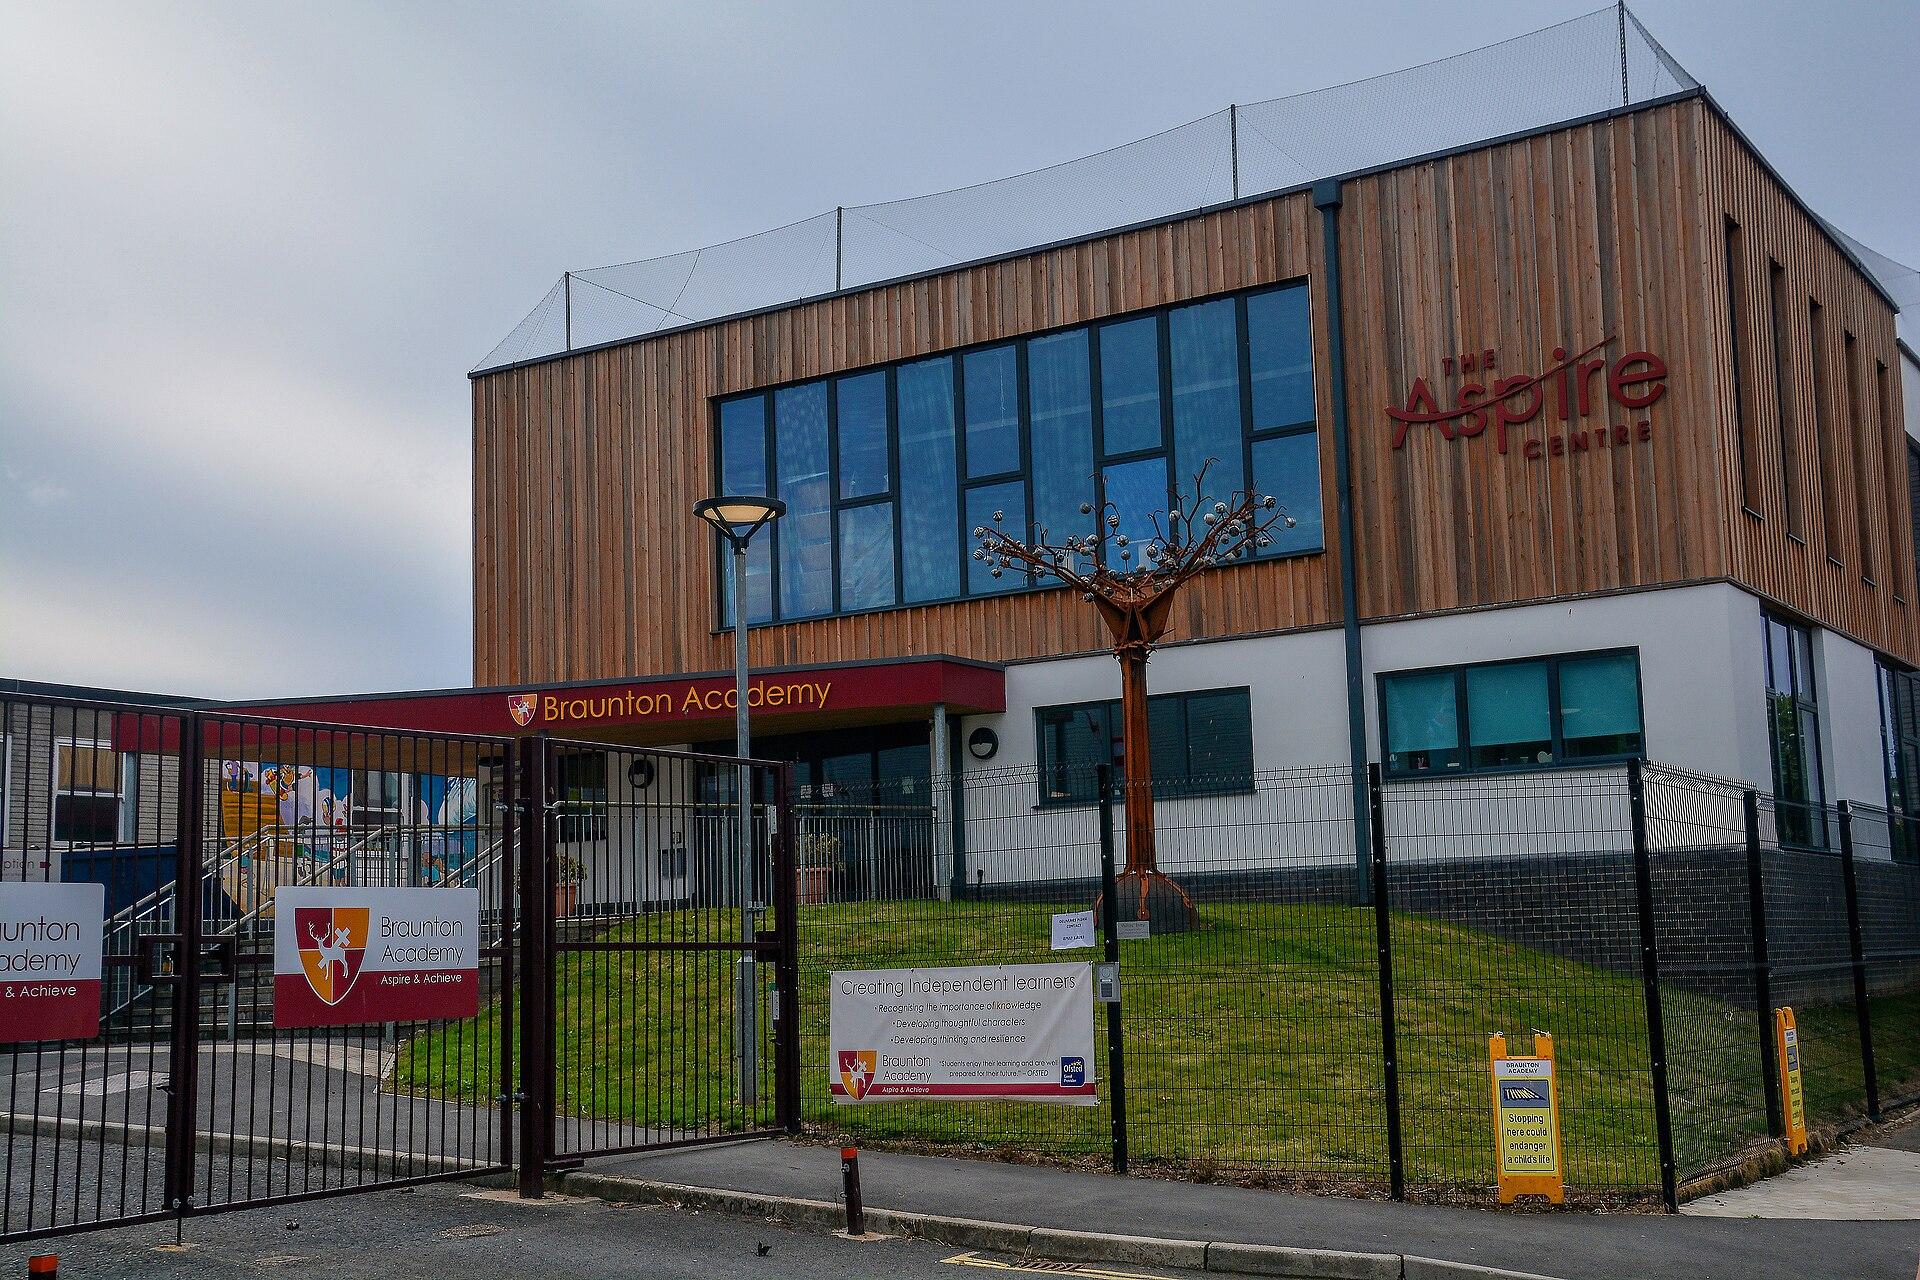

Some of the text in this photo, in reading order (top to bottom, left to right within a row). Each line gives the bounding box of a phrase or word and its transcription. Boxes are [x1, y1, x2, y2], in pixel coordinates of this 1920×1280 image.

[1442, 348, 1495, 376] THE
[1385, 335, 1667, 454] Aspire
[1523, 420, 1650, 459] CENTRE
[544, 680, 831, 721] Braunton Academy
[0, 916, 80, 941] unton
[381, 916, 463, 937] Braunton
[381, 943, 464, 965] Academy
[381, 972, 462, 986] Aspire & Achieve
[842, 975, 1076, 997] Creating Independent learners
[5, 984, 77, 998] & Achieve
[879, 1001, 1041, 1013] Recognising the importance of knowledge
[897, 1018, 1026, 1029] Developing thoughtful characters
[894, 1034, 1026, 1045] Developing thinking and resilience
[882, 1055, 931, 1067] Braunton
[883, 1070, 932, 1083] Academy
[1508, 1114, 1544, 1124] Stopping
[1507, 1128, 1547, 1137] here could
[1509, 1141, 1547, 1152] endanger
[1538, 1154, 1550, 1163] life
